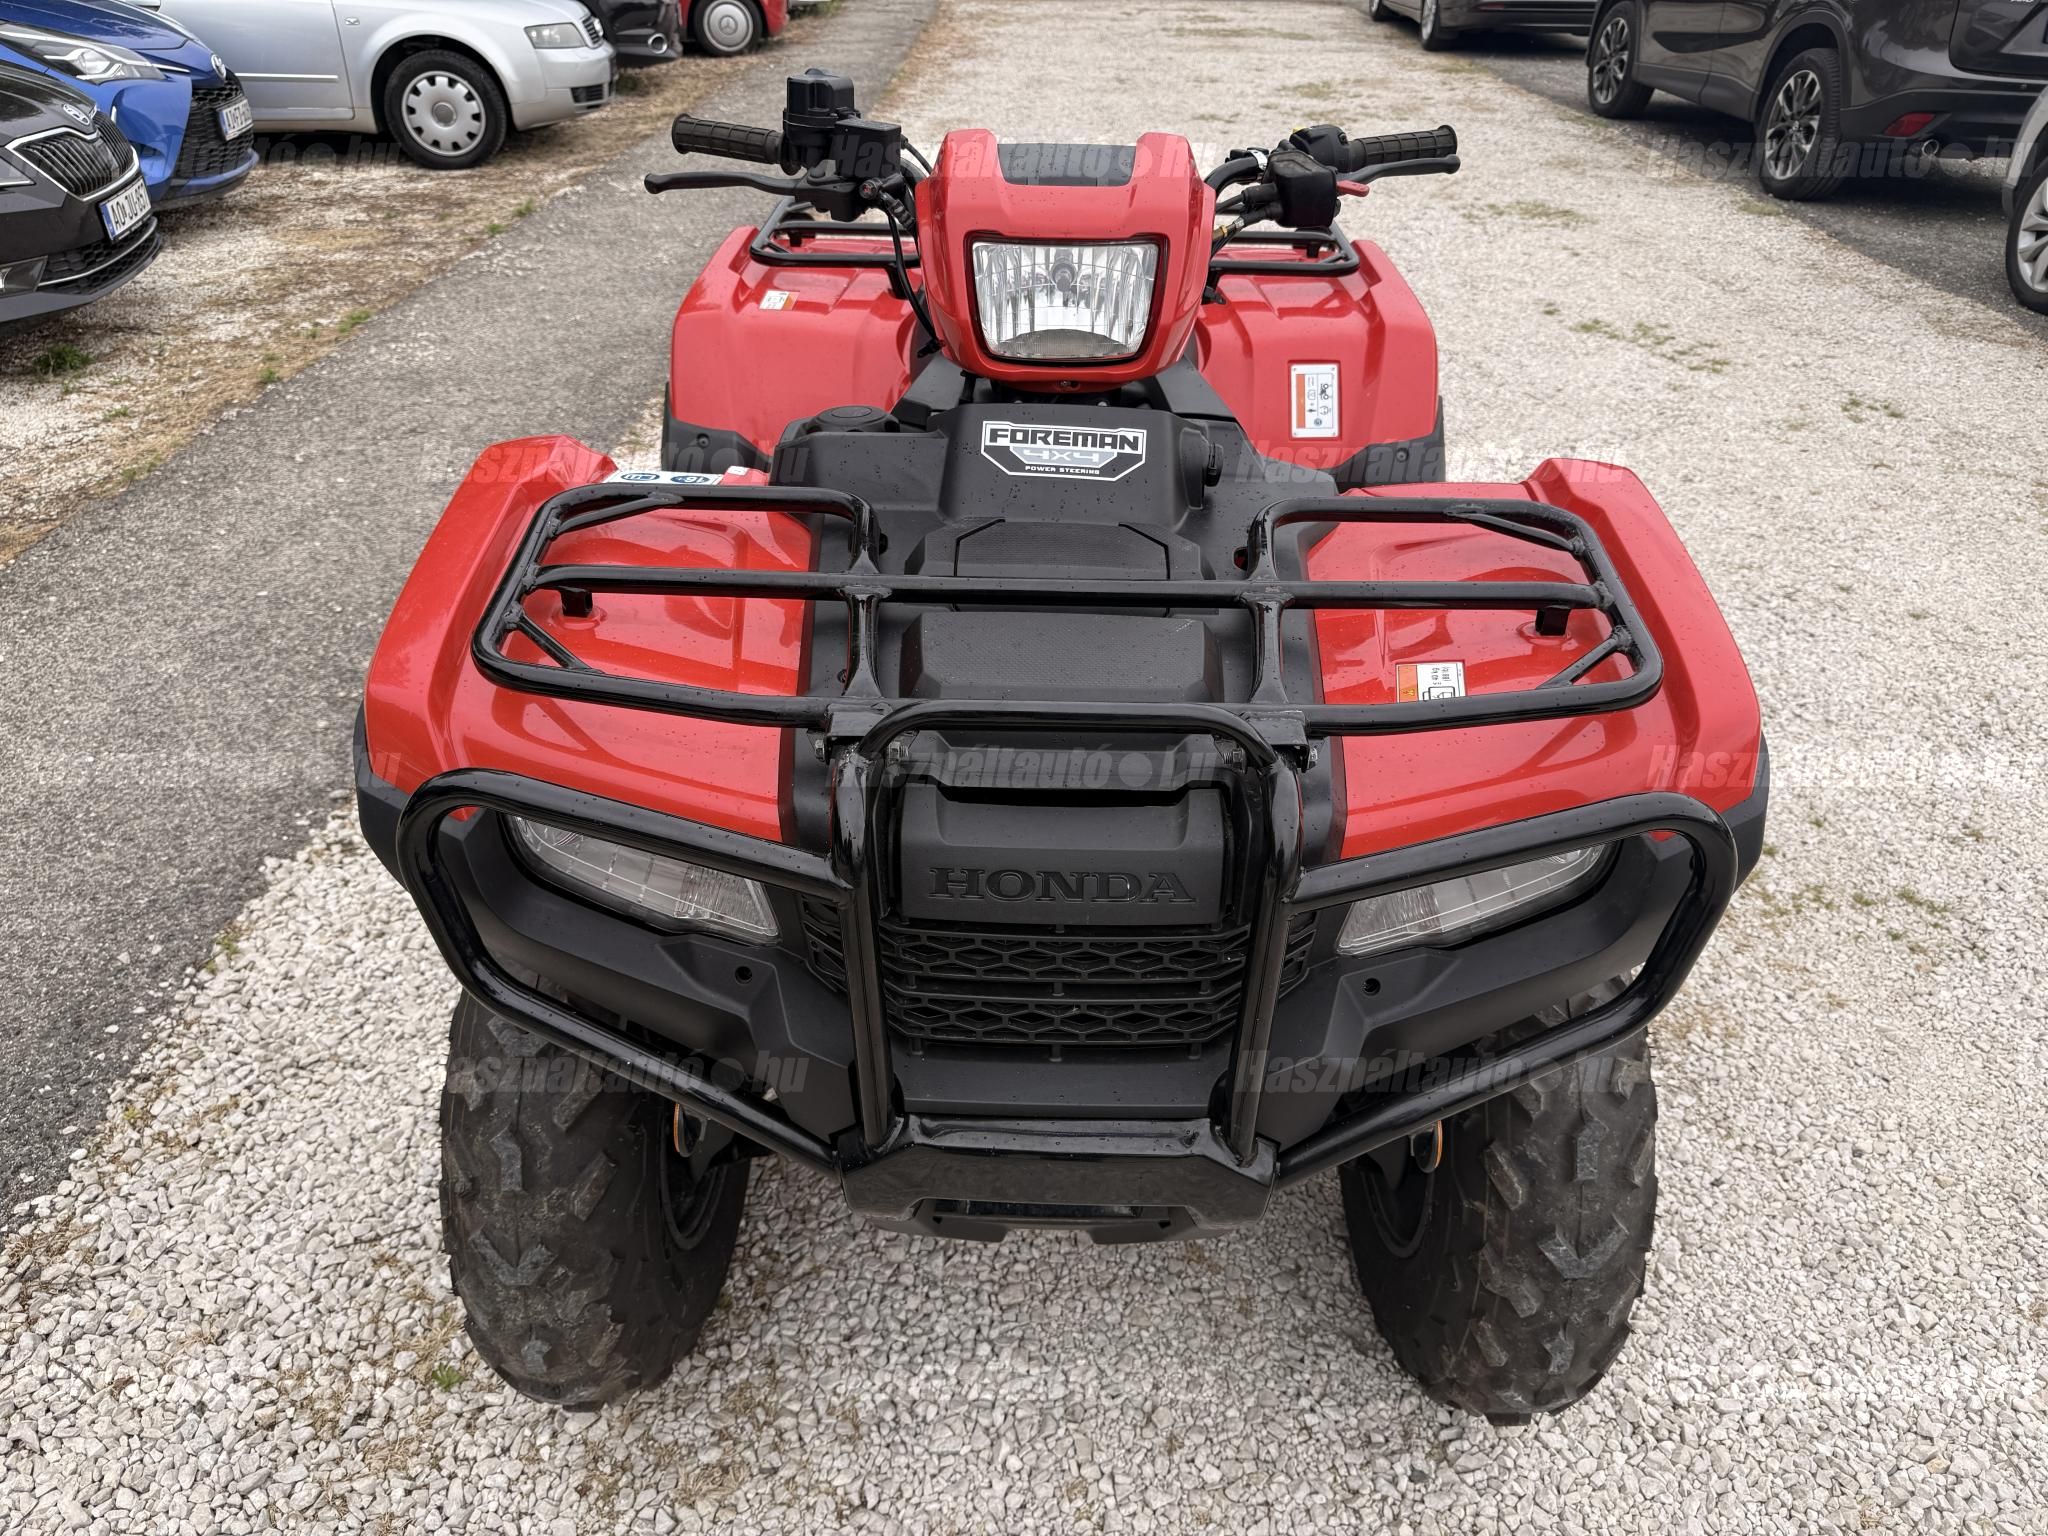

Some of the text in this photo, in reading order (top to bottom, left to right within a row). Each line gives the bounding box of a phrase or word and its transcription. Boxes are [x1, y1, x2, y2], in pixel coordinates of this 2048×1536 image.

[989, 428, 1140, 452] FOREMAN
[1025, 465, 1100, 475] POWER STEERING
[928, 867, 1197, 904] HONDA
